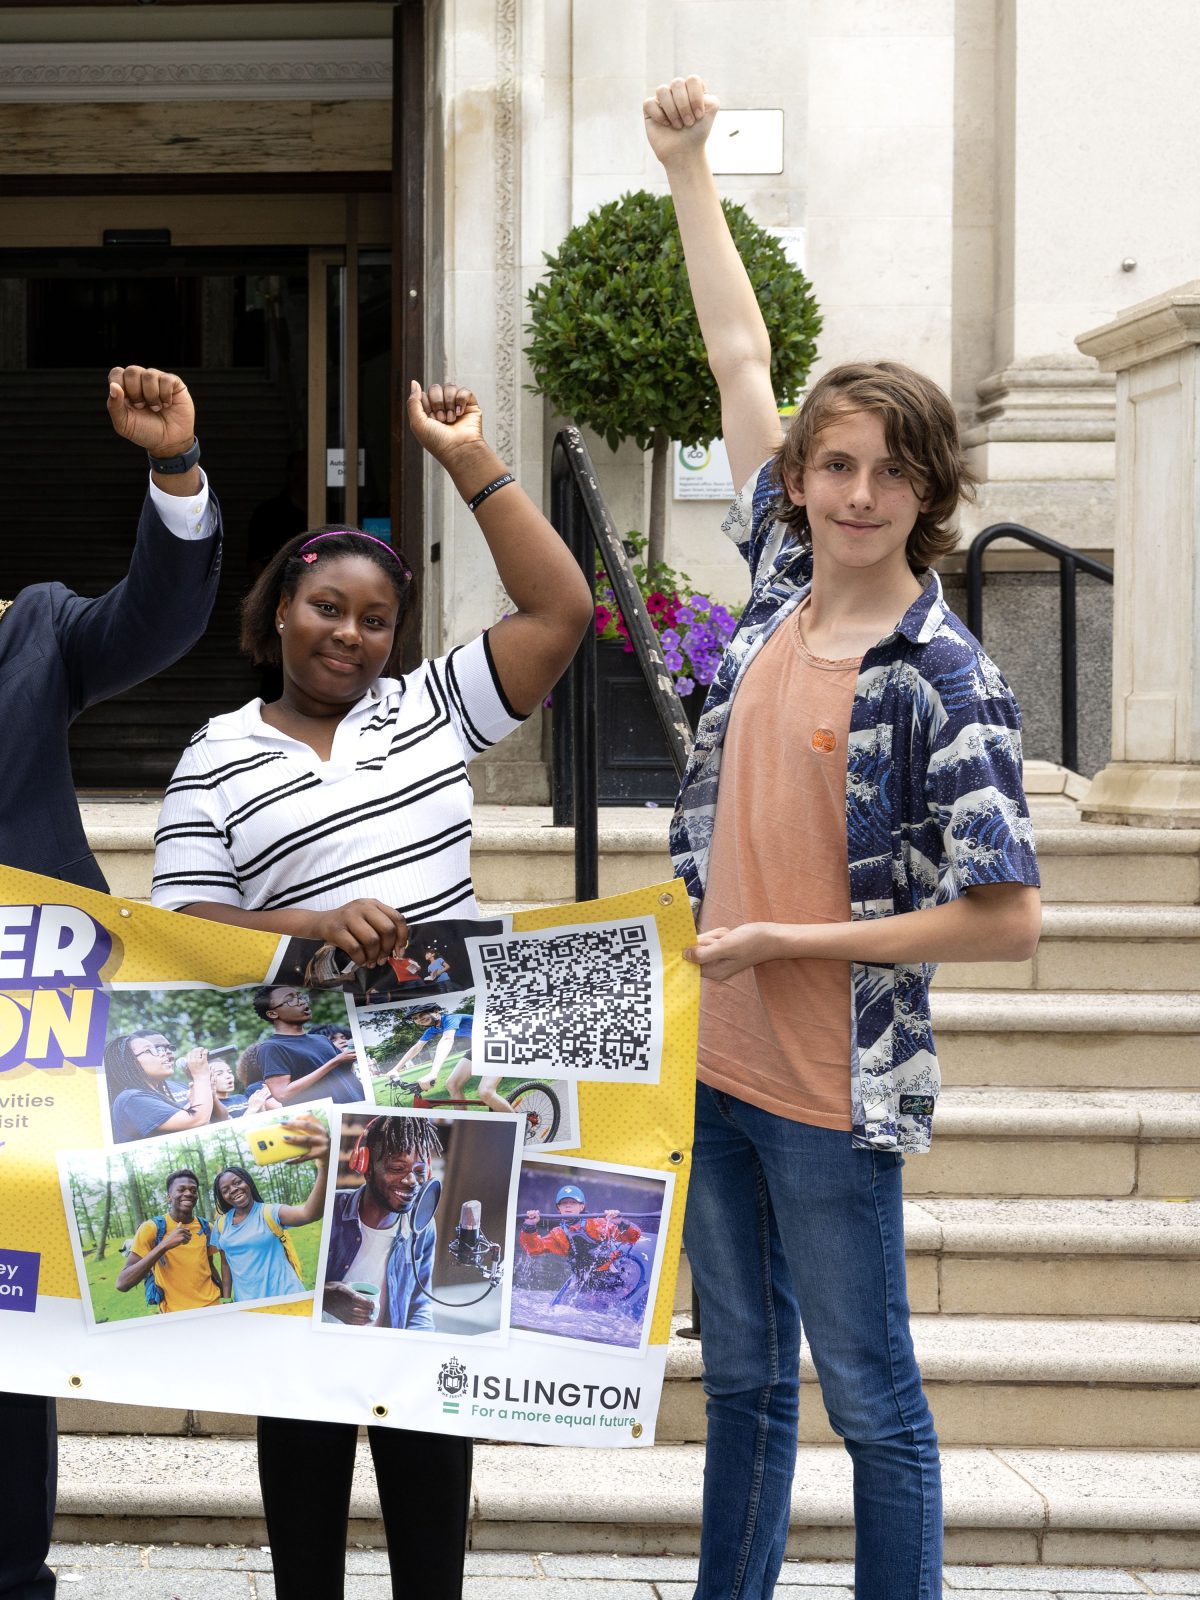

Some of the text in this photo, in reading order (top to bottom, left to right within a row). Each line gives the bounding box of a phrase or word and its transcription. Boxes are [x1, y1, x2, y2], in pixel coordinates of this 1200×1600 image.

[472, 1375, 641, 1410] ISLINGTON
[471, 1405, 636, 1428] For a more equal future
